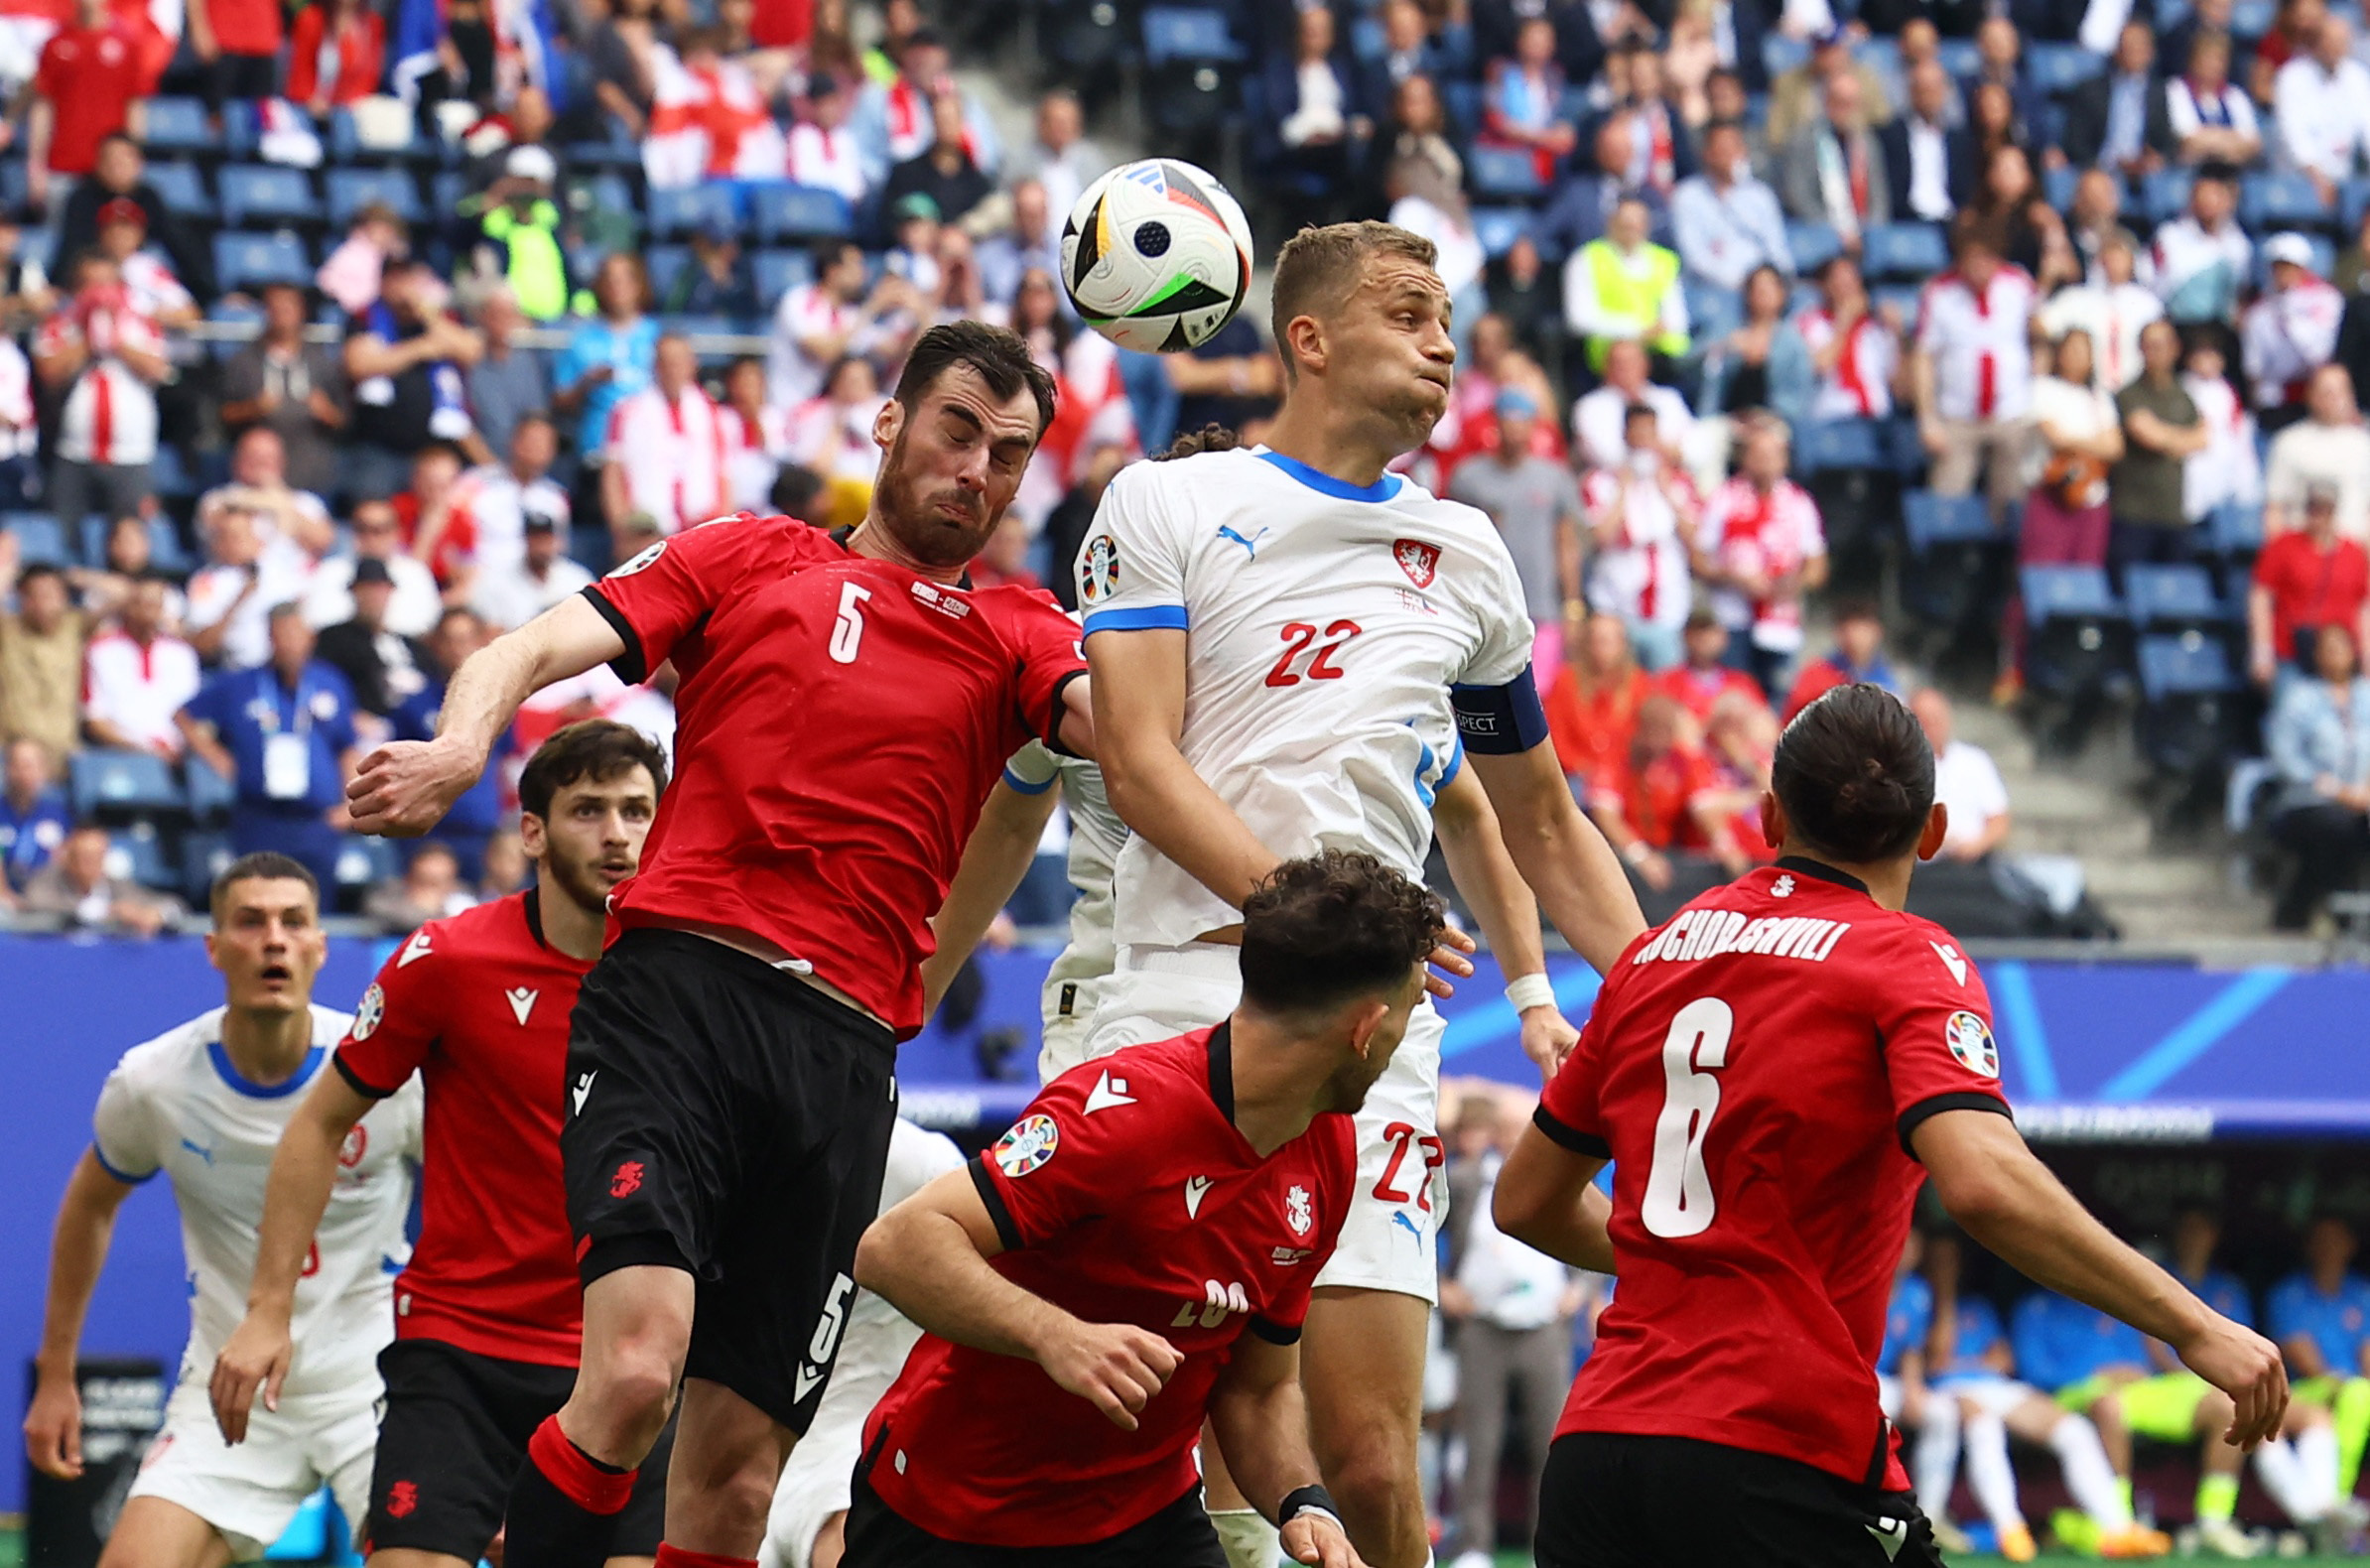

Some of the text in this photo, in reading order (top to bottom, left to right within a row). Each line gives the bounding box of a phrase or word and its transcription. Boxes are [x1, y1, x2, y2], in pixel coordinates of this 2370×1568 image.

[828, 581, 872, 664] 5
[1264, 618, 1362, 688] 22
[1641, 996, 1734, 1239] 6
[809, 1271, 854, 1365] 5
